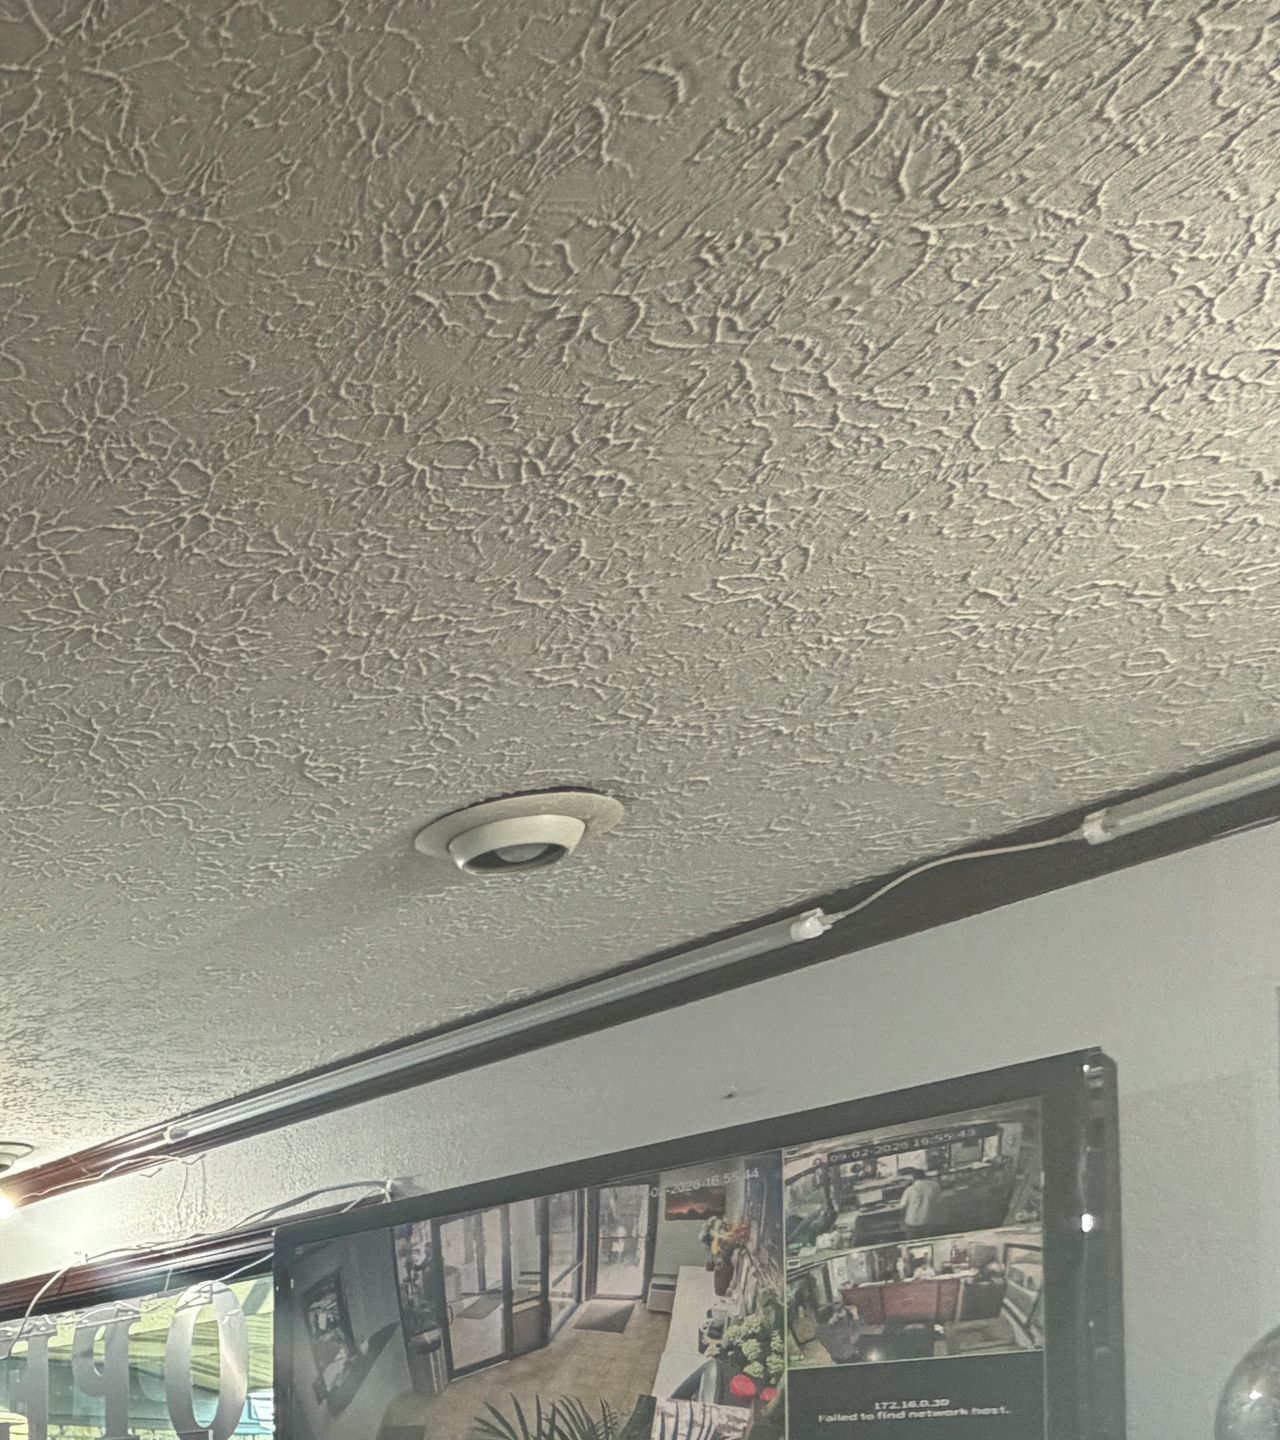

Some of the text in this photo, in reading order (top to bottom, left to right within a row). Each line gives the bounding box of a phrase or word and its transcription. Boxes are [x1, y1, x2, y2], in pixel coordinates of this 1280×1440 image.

[818, 1406, 1010, 1423] Failed to find network host.
